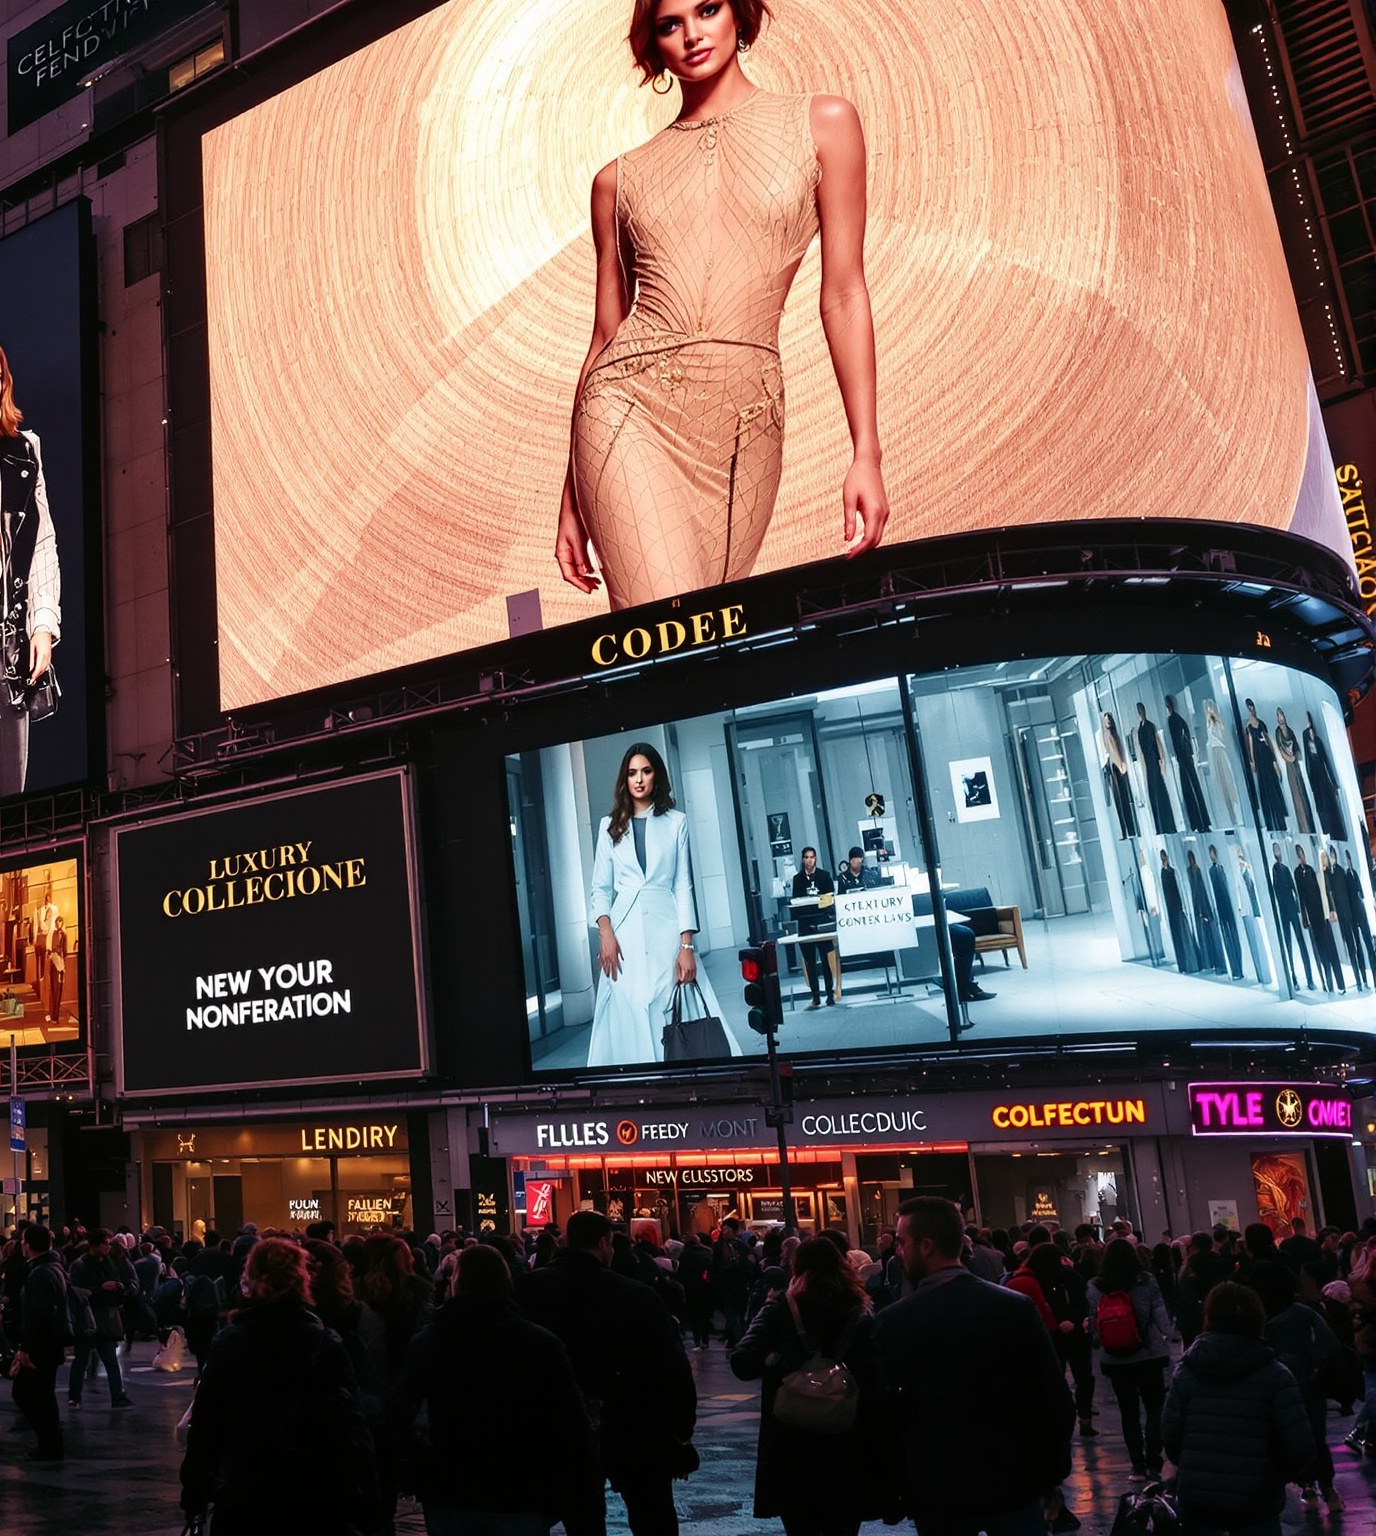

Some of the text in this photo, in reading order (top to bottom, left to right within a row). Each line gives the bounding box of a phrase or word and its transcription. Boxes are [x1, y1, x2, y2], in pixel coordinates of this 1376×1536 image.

[591, 604, 747, 666] CODEE
[208, 841, 313, 881] LUXURY
[162, 857, 367, 918] COLLECIONE
[195, 958, 333, 1000] NEW YOUR
[186, 989, 352, 1030] NONFERATION
[641, 1122, 690, 1140] FEEDY
[699, 1118, 758, 1138] MONT
[801, 1110, 928, 1136] COLLECDUIC
[992, 1099, 1146, 1129] COLFECTUN
[1196, 1092, 1264, 1126] TYLE
[301, 1124, 398, 1151] LENDIRY
[646, 1170, 678, 1185] NEW
